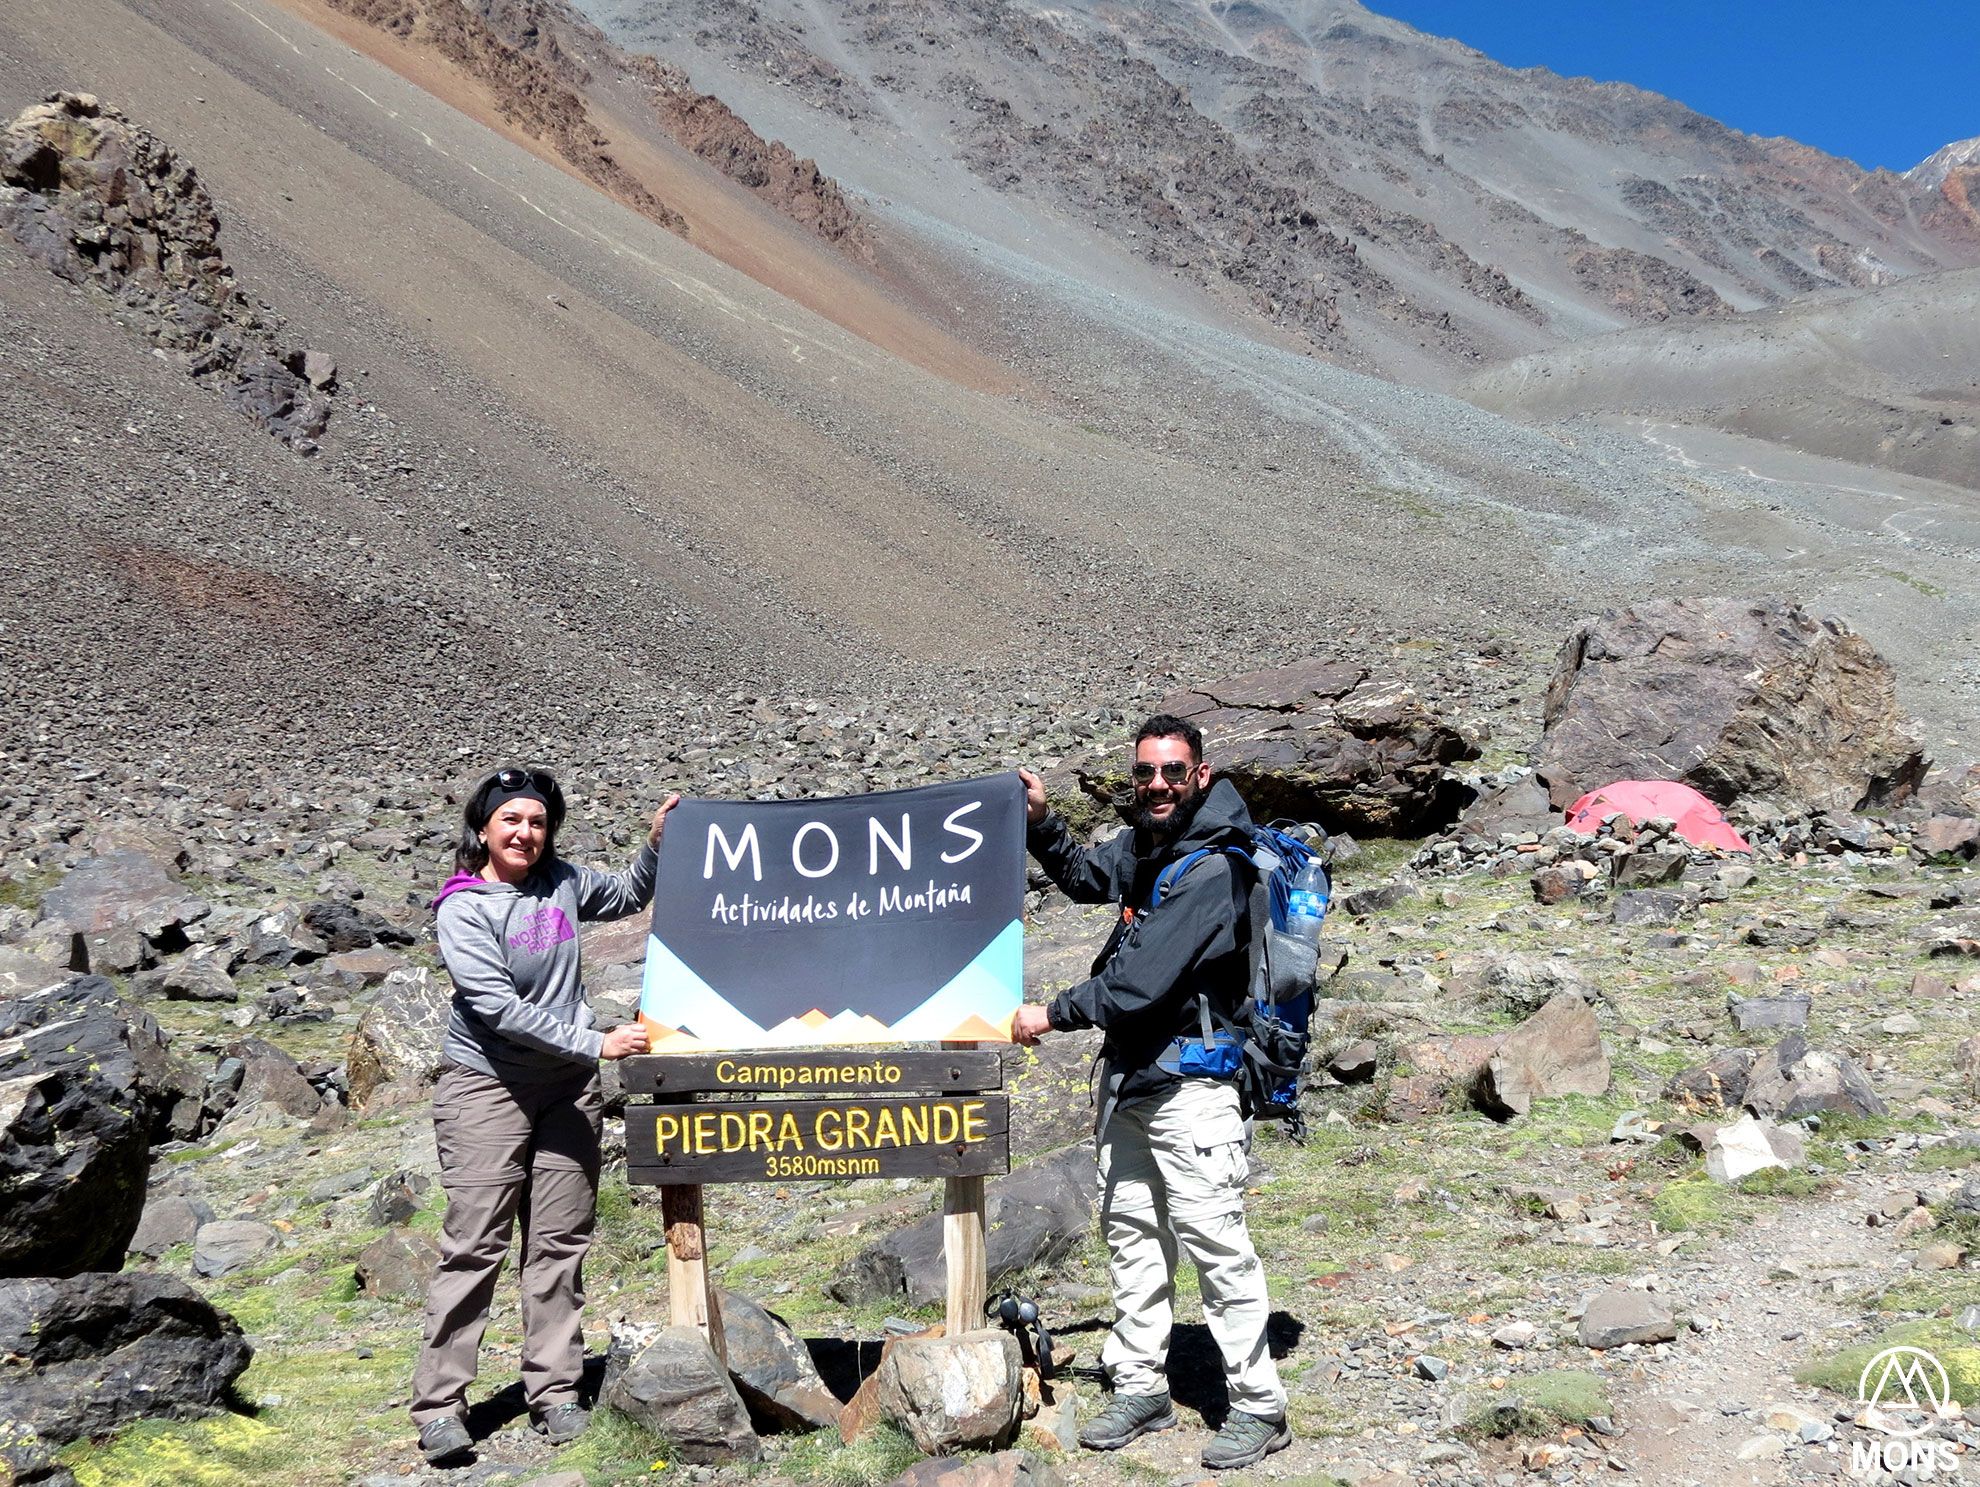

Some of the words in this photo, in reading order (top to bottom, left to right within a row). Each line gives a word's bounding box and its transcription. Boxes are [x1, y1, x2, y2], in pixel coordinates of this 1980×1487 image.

[703, 801, 984, 881] MONS
[711, 893, 838, 926] Actividades
[846, 892, 869, 921] de
[879, 880, 971, 917] Montaña
[523, 909, 547, 927] THE
[509, 923, 550, 949] NORTH
[529, 931, 560, 955] FACE
[716, 1060, 901, 1088] Campamento
[655, 1111, 804, 1155] PIEDRA
[815, 1101, 987, 1151] GRANDE
[765, 1156, 879, 1178] 3580msnm
